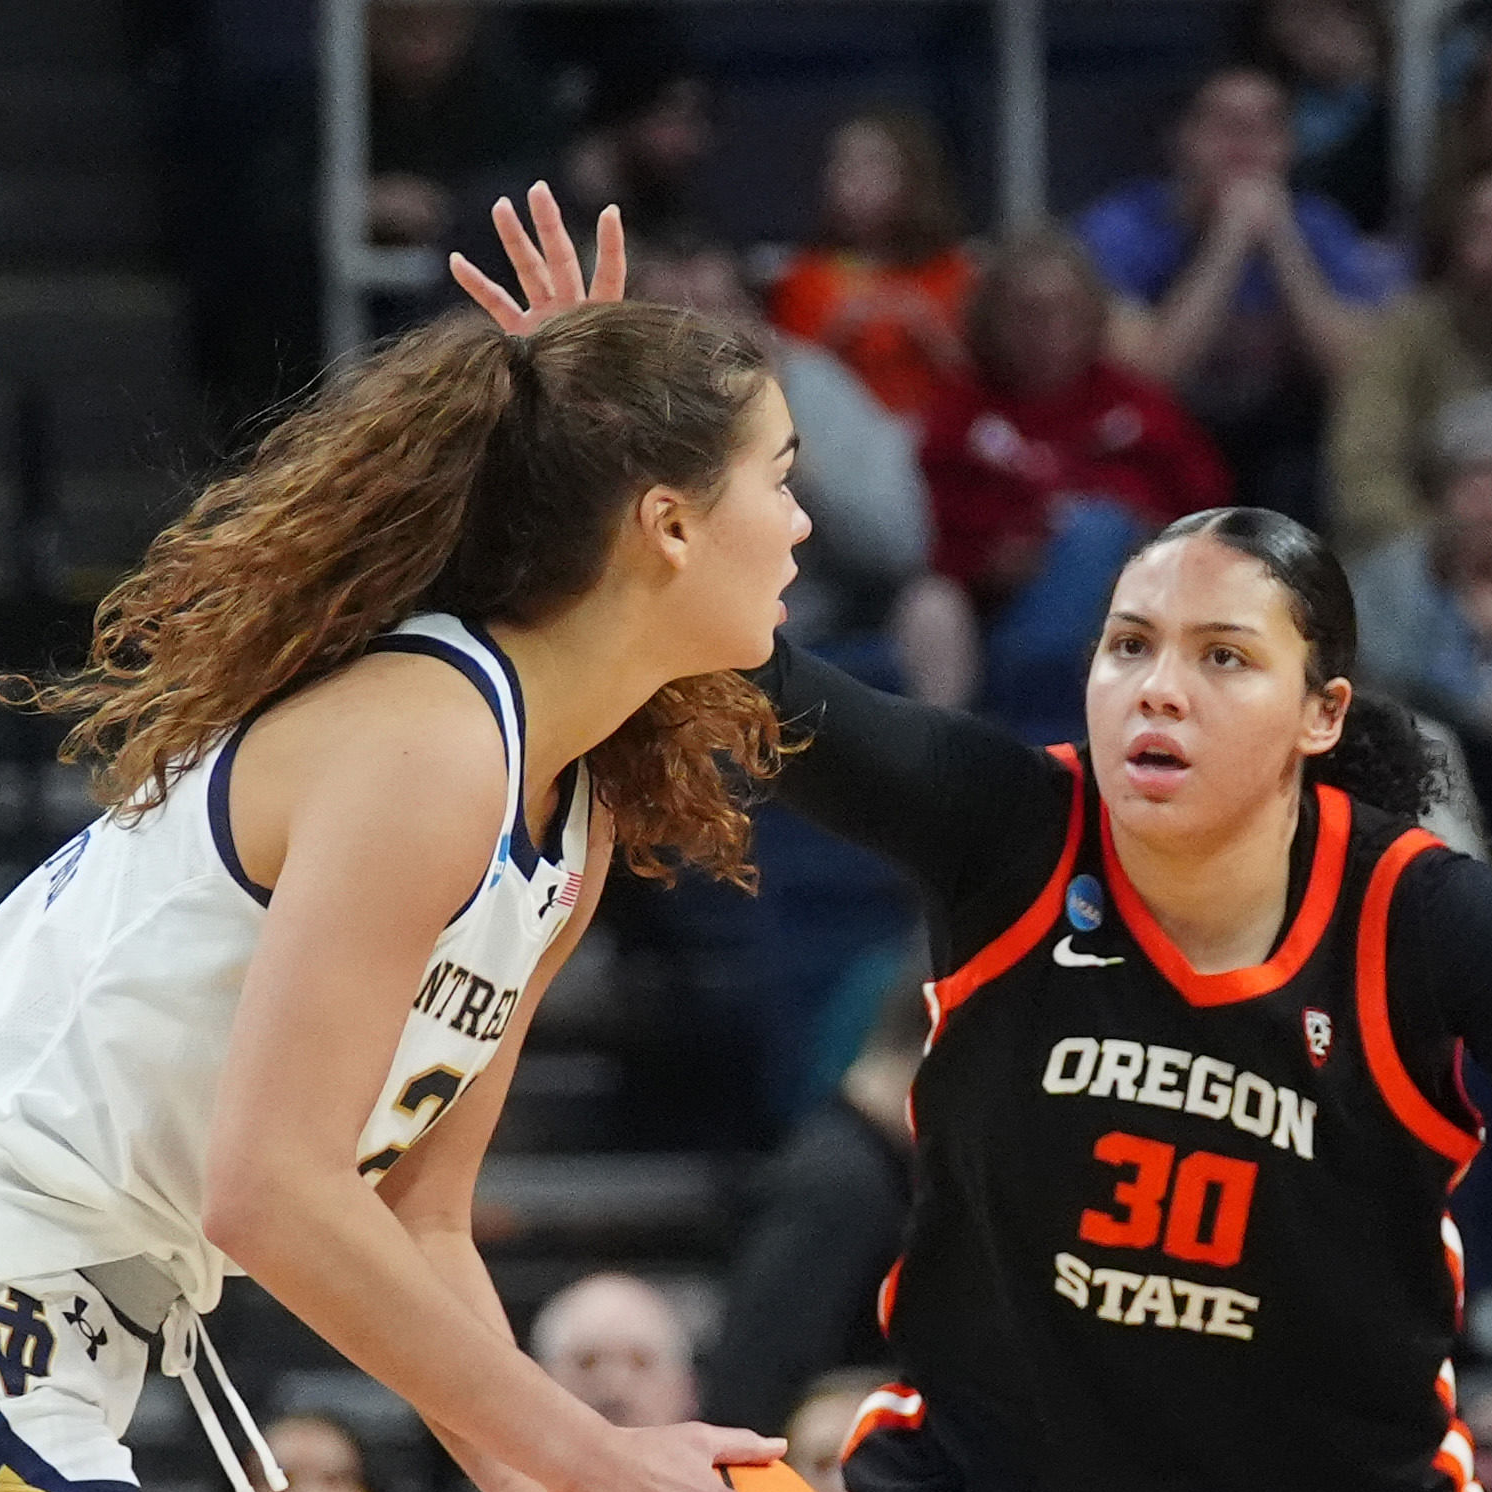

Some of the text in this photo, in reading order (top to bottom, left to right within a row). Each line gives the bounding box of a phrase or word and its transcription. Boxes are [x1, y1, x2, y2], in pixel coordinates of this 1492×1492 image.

[1042, 1037, 1318, 1160] OREGON
[1079, 1130, 1259, 1268] 30
[1054, 1252, 1261, 1341] STATE
